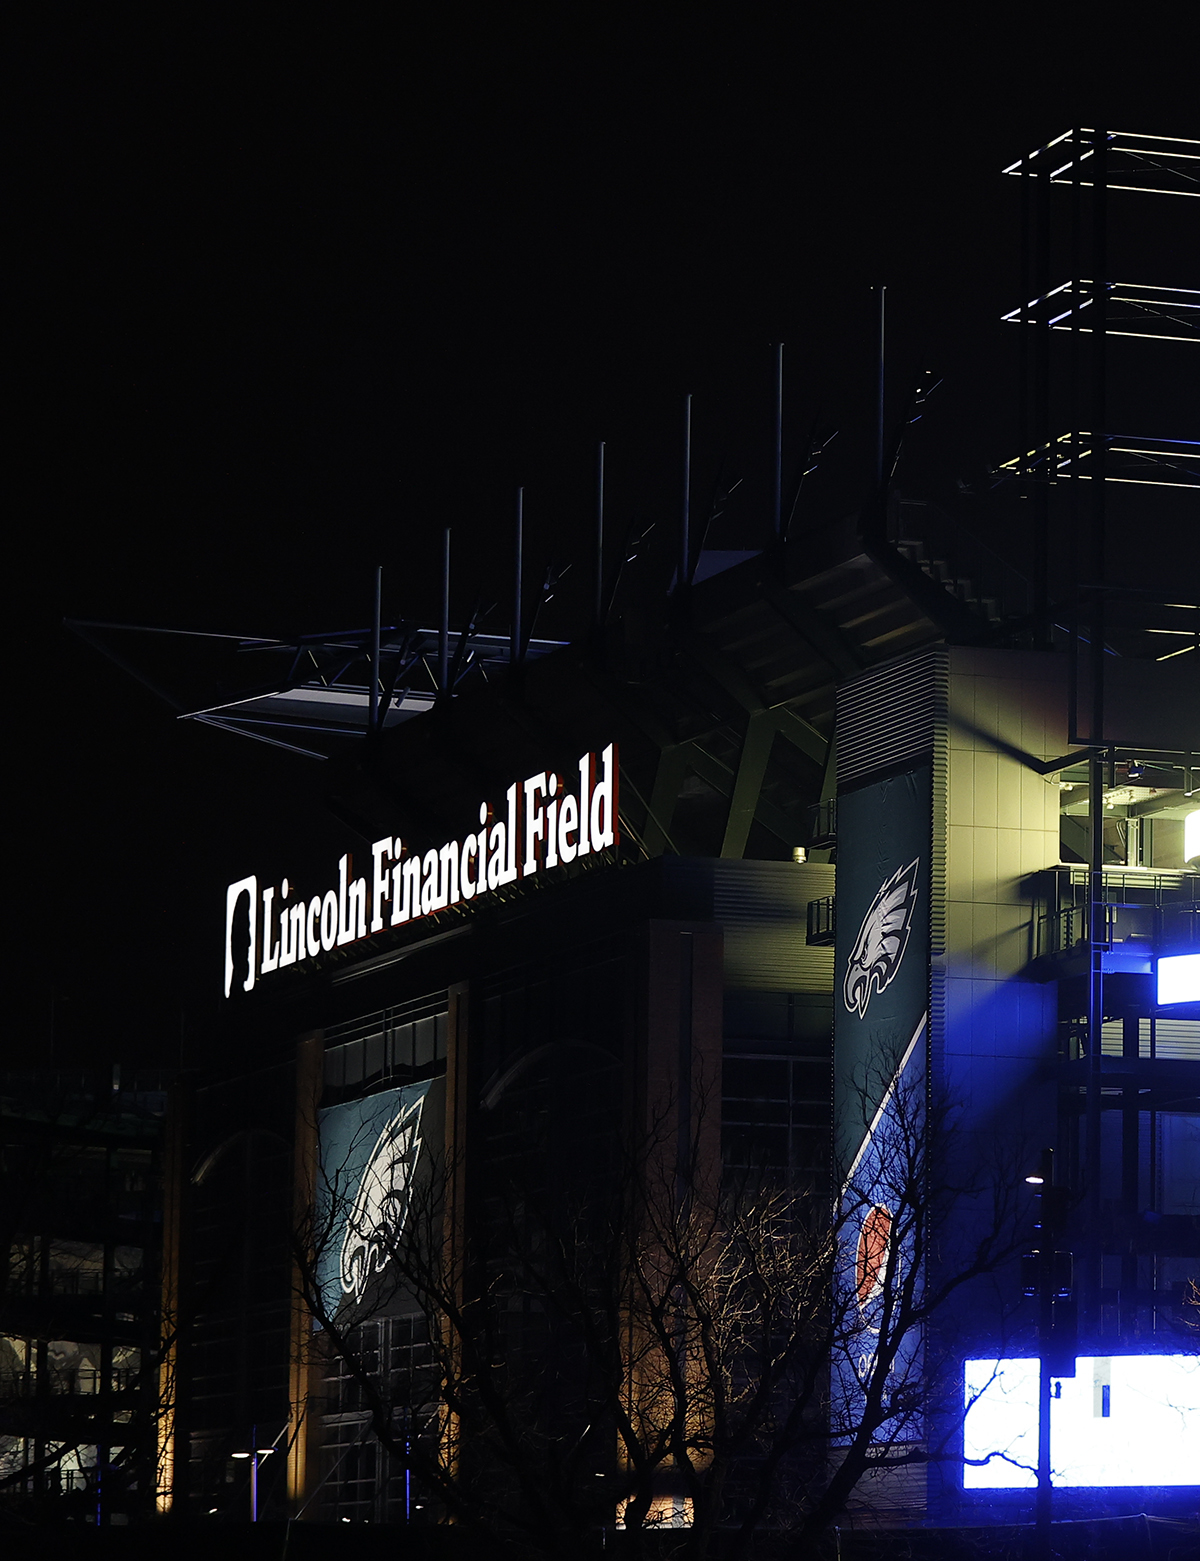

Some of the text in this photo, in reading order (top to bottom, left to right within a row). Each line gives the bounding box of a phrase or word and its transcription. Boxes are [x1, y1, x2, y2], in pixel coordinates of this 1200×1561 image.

[260, 742, 618, 975] Lincoln Financial Field
